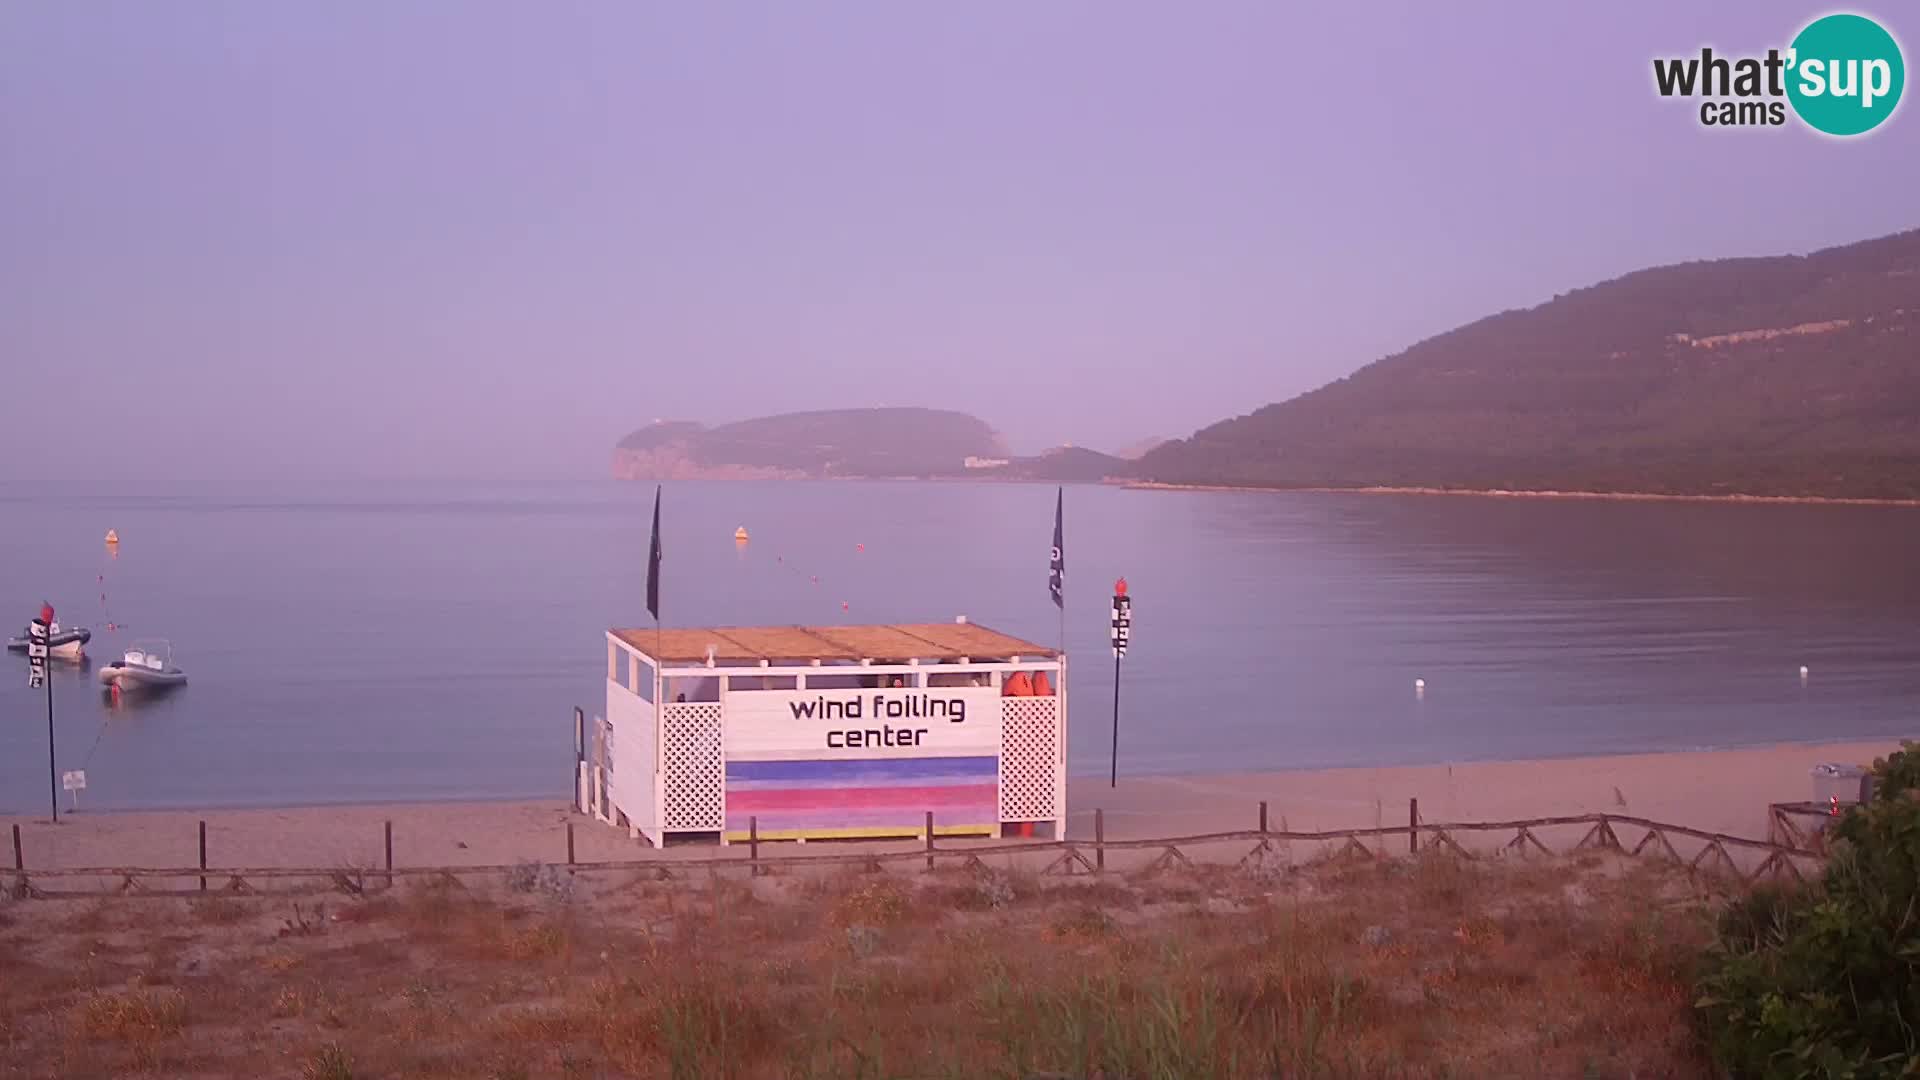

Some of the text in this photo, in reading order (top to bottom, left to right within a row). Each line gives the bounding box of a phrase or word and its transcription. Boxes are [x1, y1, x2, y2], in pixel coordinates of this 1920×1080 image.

[789, 694, 966, 723] wind foiling
[826, 725, 928, 748] center
